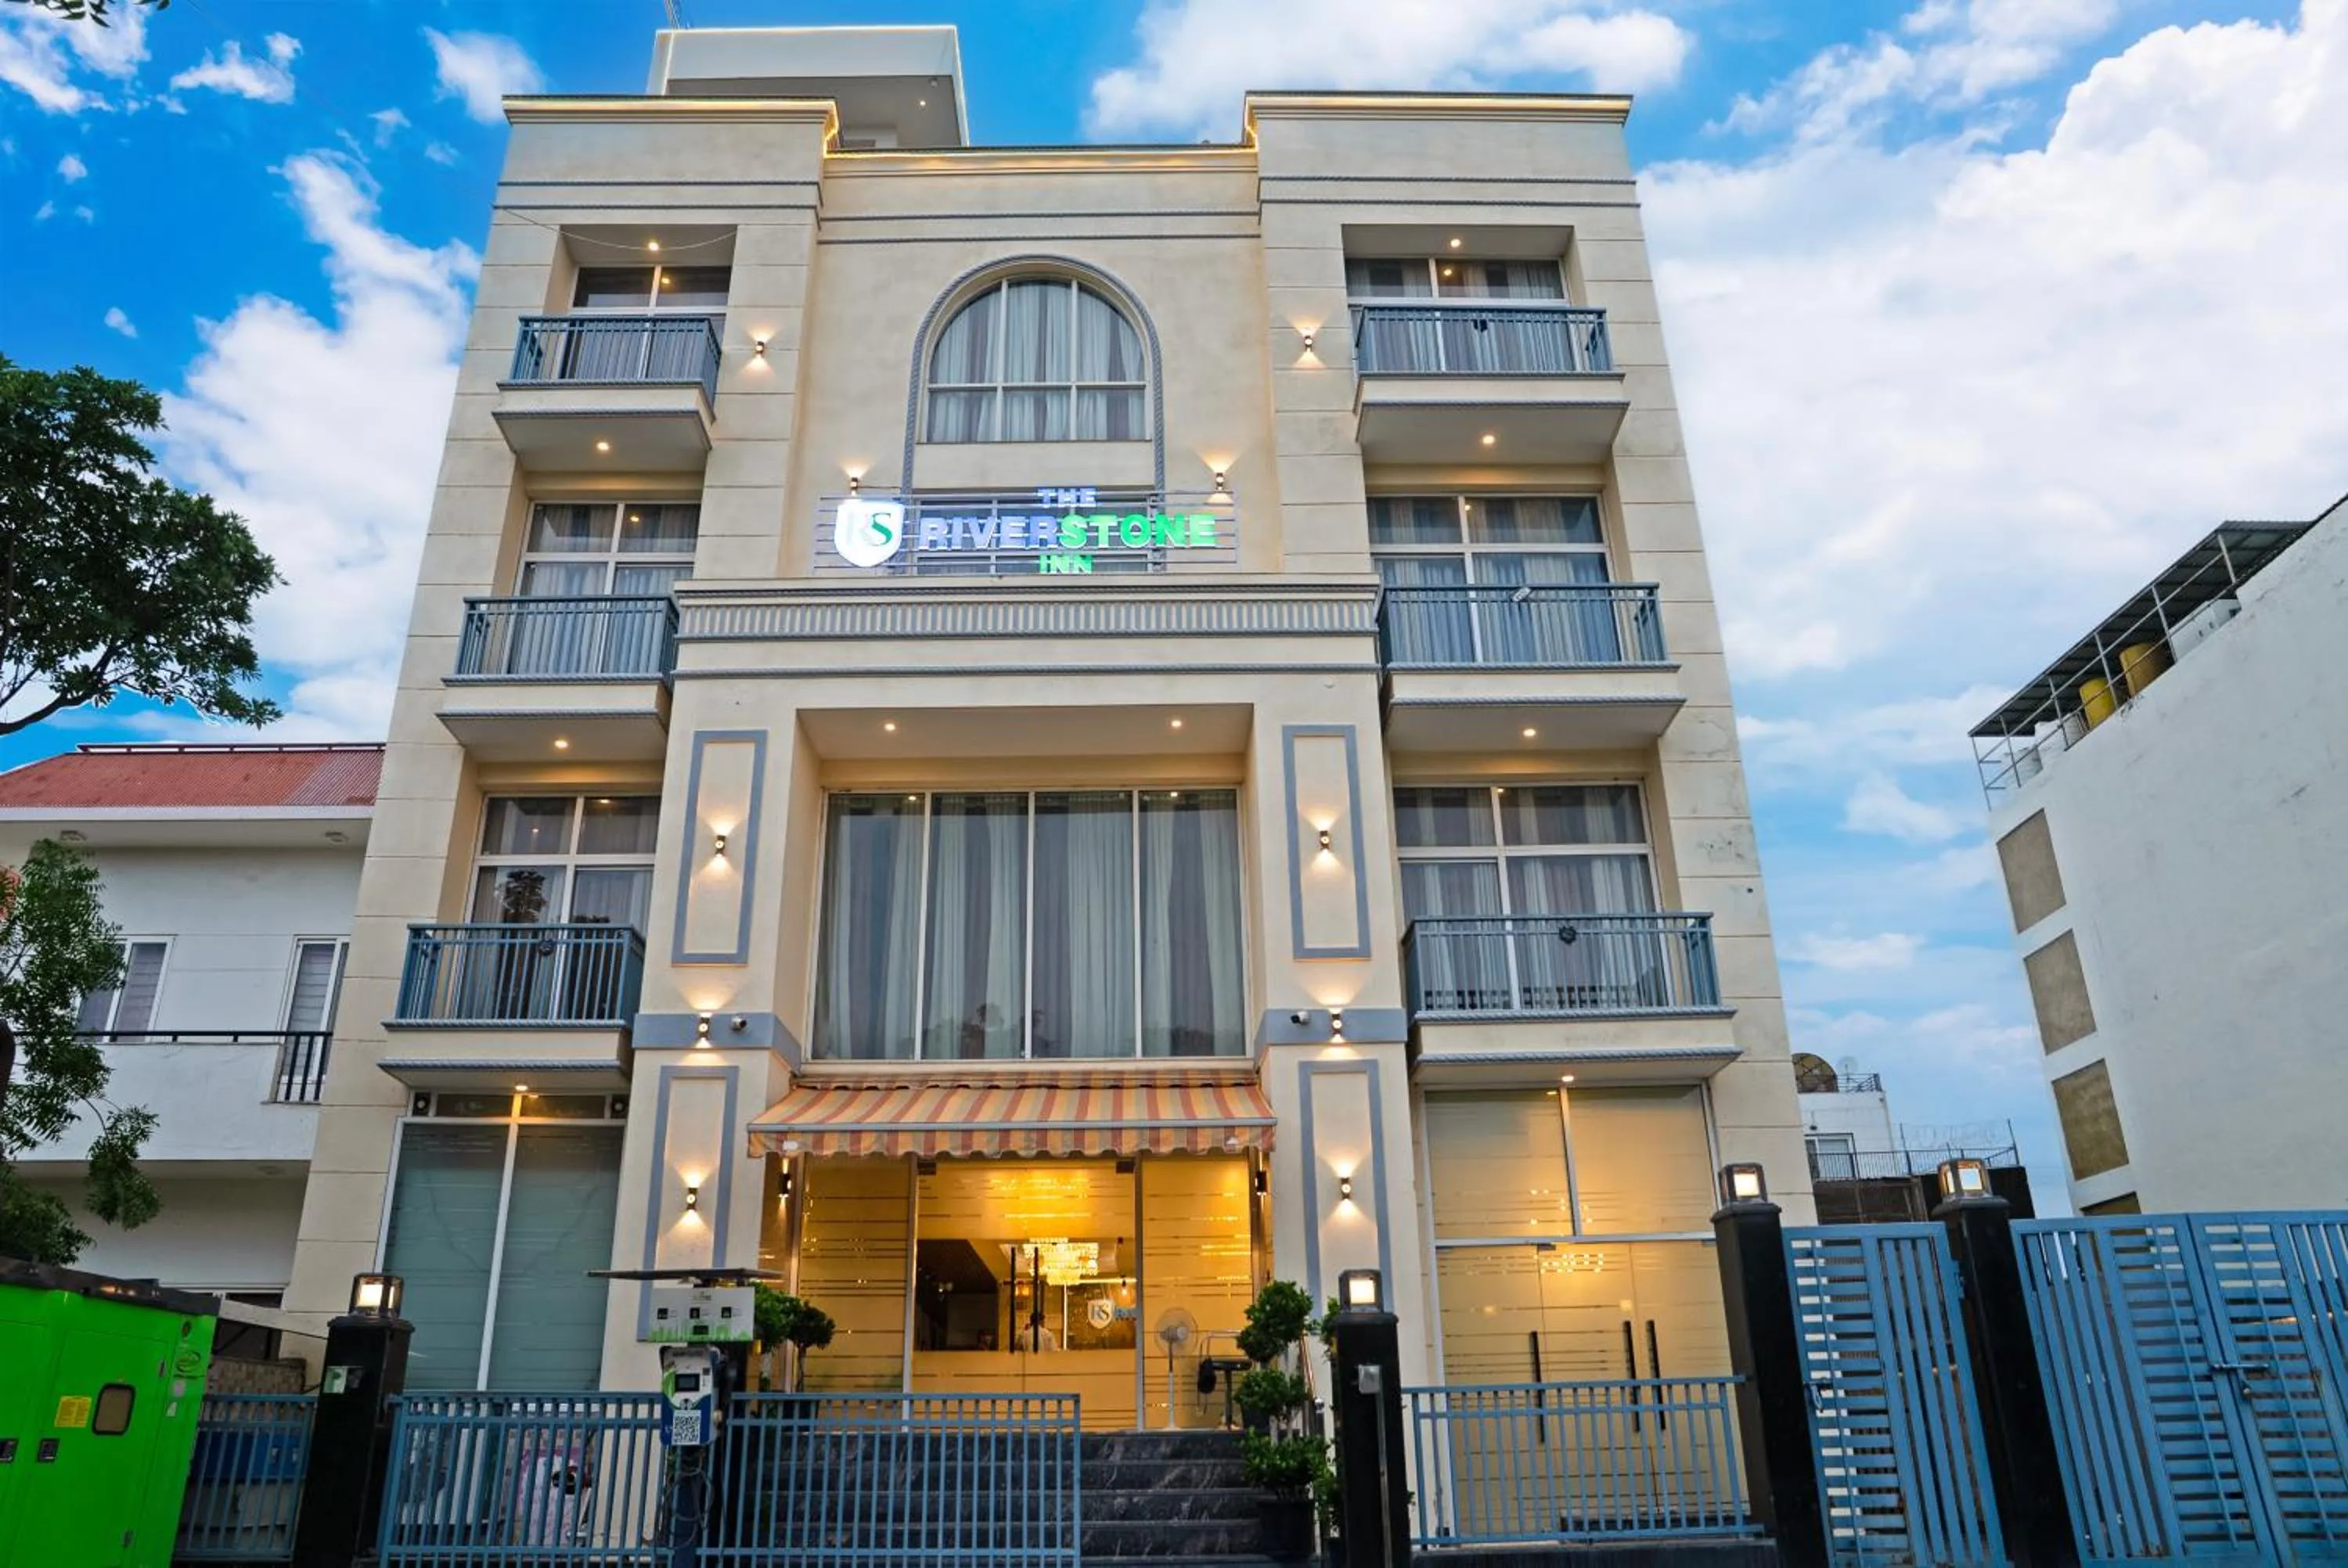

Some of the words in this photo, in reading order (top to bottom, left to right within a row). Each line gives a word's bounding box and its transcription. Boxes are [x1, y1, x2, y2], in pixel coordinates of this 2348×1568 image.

[1037, 487, 1097, 508] THE
[918, 512, 1216, 549] RIVERSTONE
[1039, 554, 1092, 574] INN
